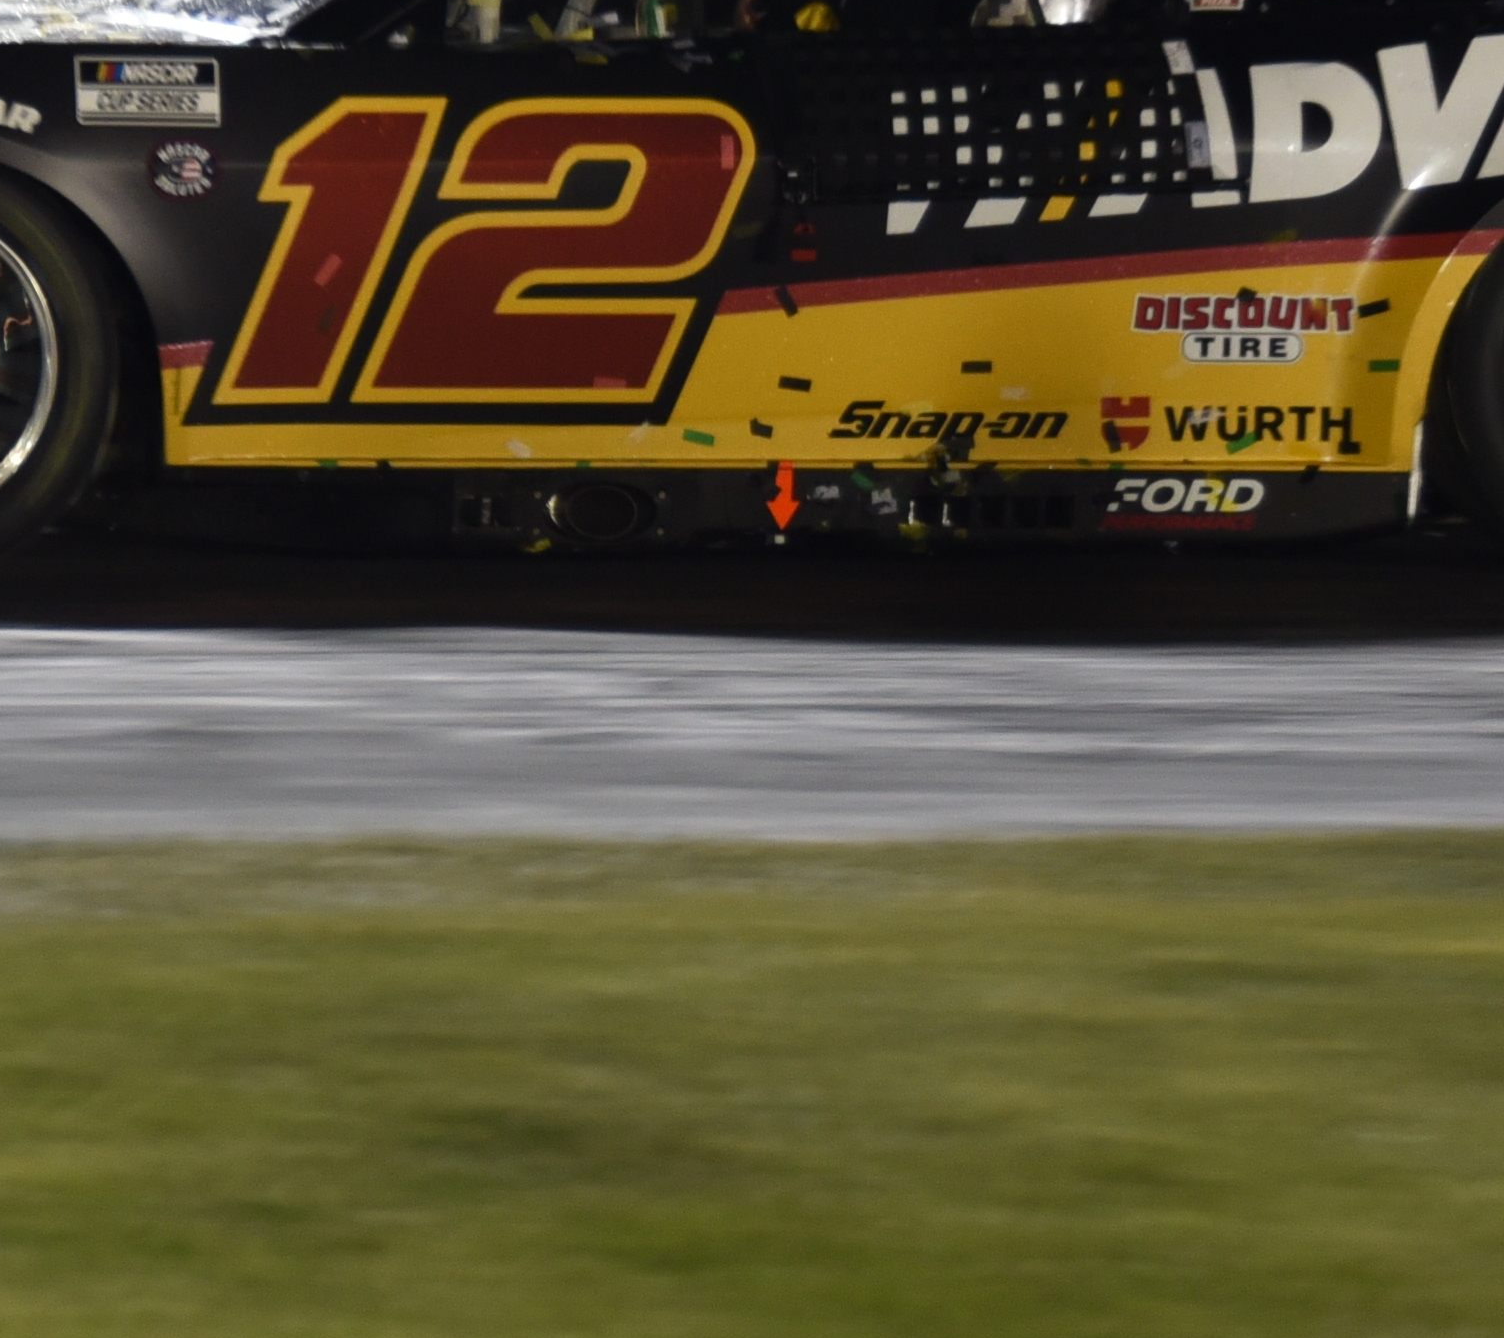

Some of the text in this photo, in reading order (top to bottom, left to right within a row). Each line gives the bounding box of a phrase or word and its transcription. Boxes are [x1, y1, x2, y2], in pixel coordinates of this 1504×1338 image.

[121, 63, 199, 83] NASCAR
[211, 95, 756, 405] 12
[1133, 294, 1356, 334] DISCOUNT
[1193, 337, 1289, 359] TIRE
[827, 400, 1069, 443] Snap-on
[1105, 477, 1266, 513] FORD
